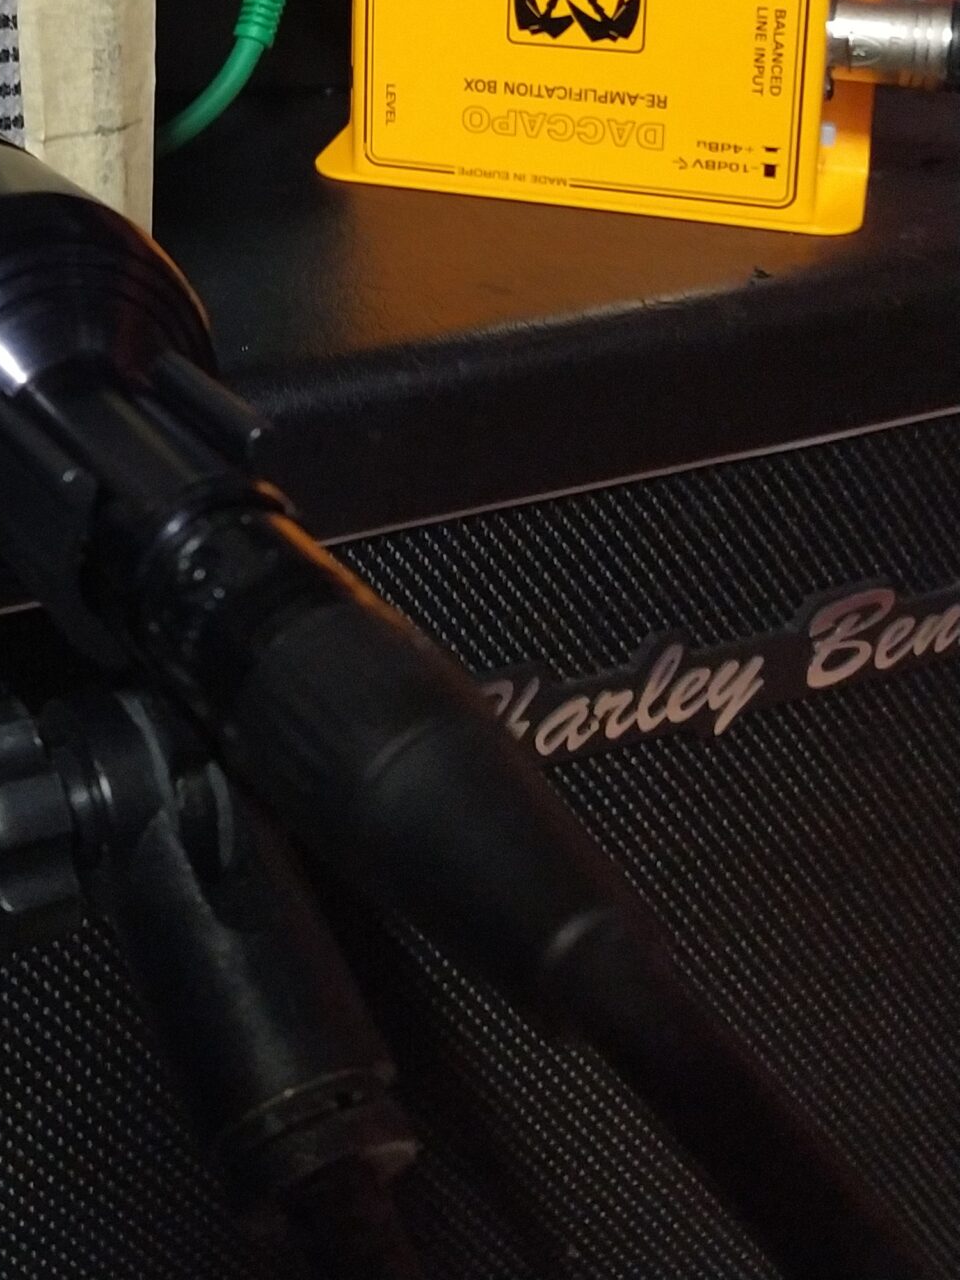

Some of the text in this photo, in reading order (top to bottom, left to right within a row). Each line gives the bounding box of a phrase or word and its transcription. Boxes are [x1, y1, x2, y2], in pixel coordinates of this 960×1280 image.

[750, 6, 768, 96] LINE INPUT
[768, 8, 787, 98] BALANCED
[385, 83, 396, 126] LEVEL
[464, 78, 668, 110] RE-AMPLIFICATION BOX
[462, 105, 665, 152] DACCAPO
[456, 166, 568, 188] MADE IN EUROPE
